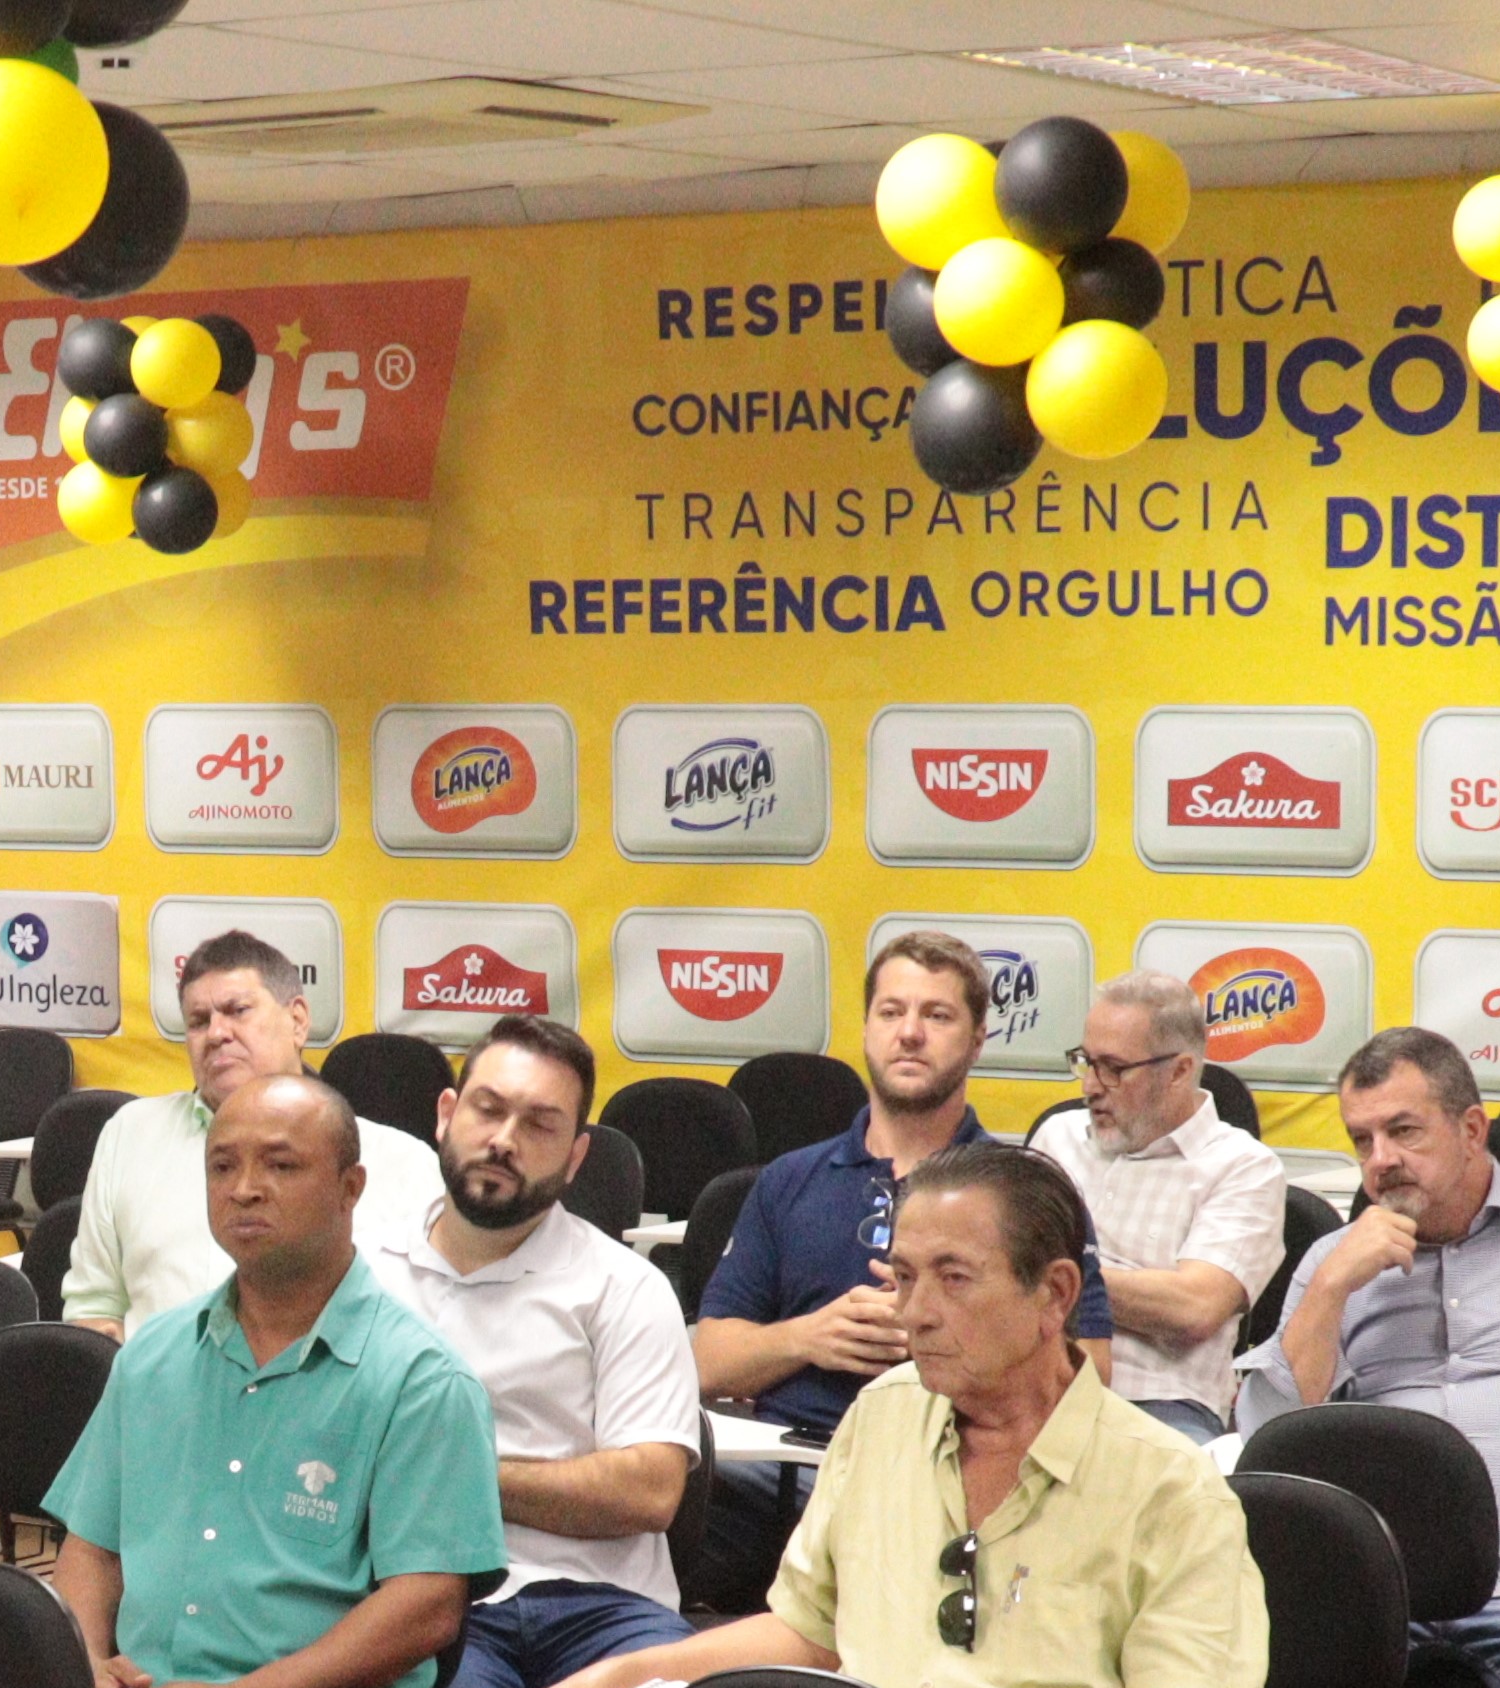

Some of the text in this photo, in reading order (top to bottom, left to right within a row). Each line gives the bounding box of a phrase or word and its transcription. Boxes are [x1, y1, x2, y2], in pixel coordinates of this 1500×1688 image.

[1168, 256, 1337, 317] TICA
[658, 279, 888, 340] RESPEI
[635, 472, 1268, 540] TRANSPARÊNCIA
[529, 562, 946, 635] REFERÊNCIA
[971, 569, 1268, 617] ORGULHO
[3, 765, 95, 788] MAURI
[434, 756, 511, 799] LANÇA
[664, 749, 773, 810] LANÇA
[925, 753, 1034, 799] NISSIN
[189, 805, 292, 820] AJINOMOTO
[744, 794, 777, 831] fit
[1185, 783, 1322, 823] Sakura
[417, 972, 532, 1010] Sakura
[671, 959, 770, 999] NISSIN
[1206, 980, 1296, 1024] LANÇA
[1005, 1007, 1041, 1044] fit
[284, 1503, 337, 1524] VIDROS
